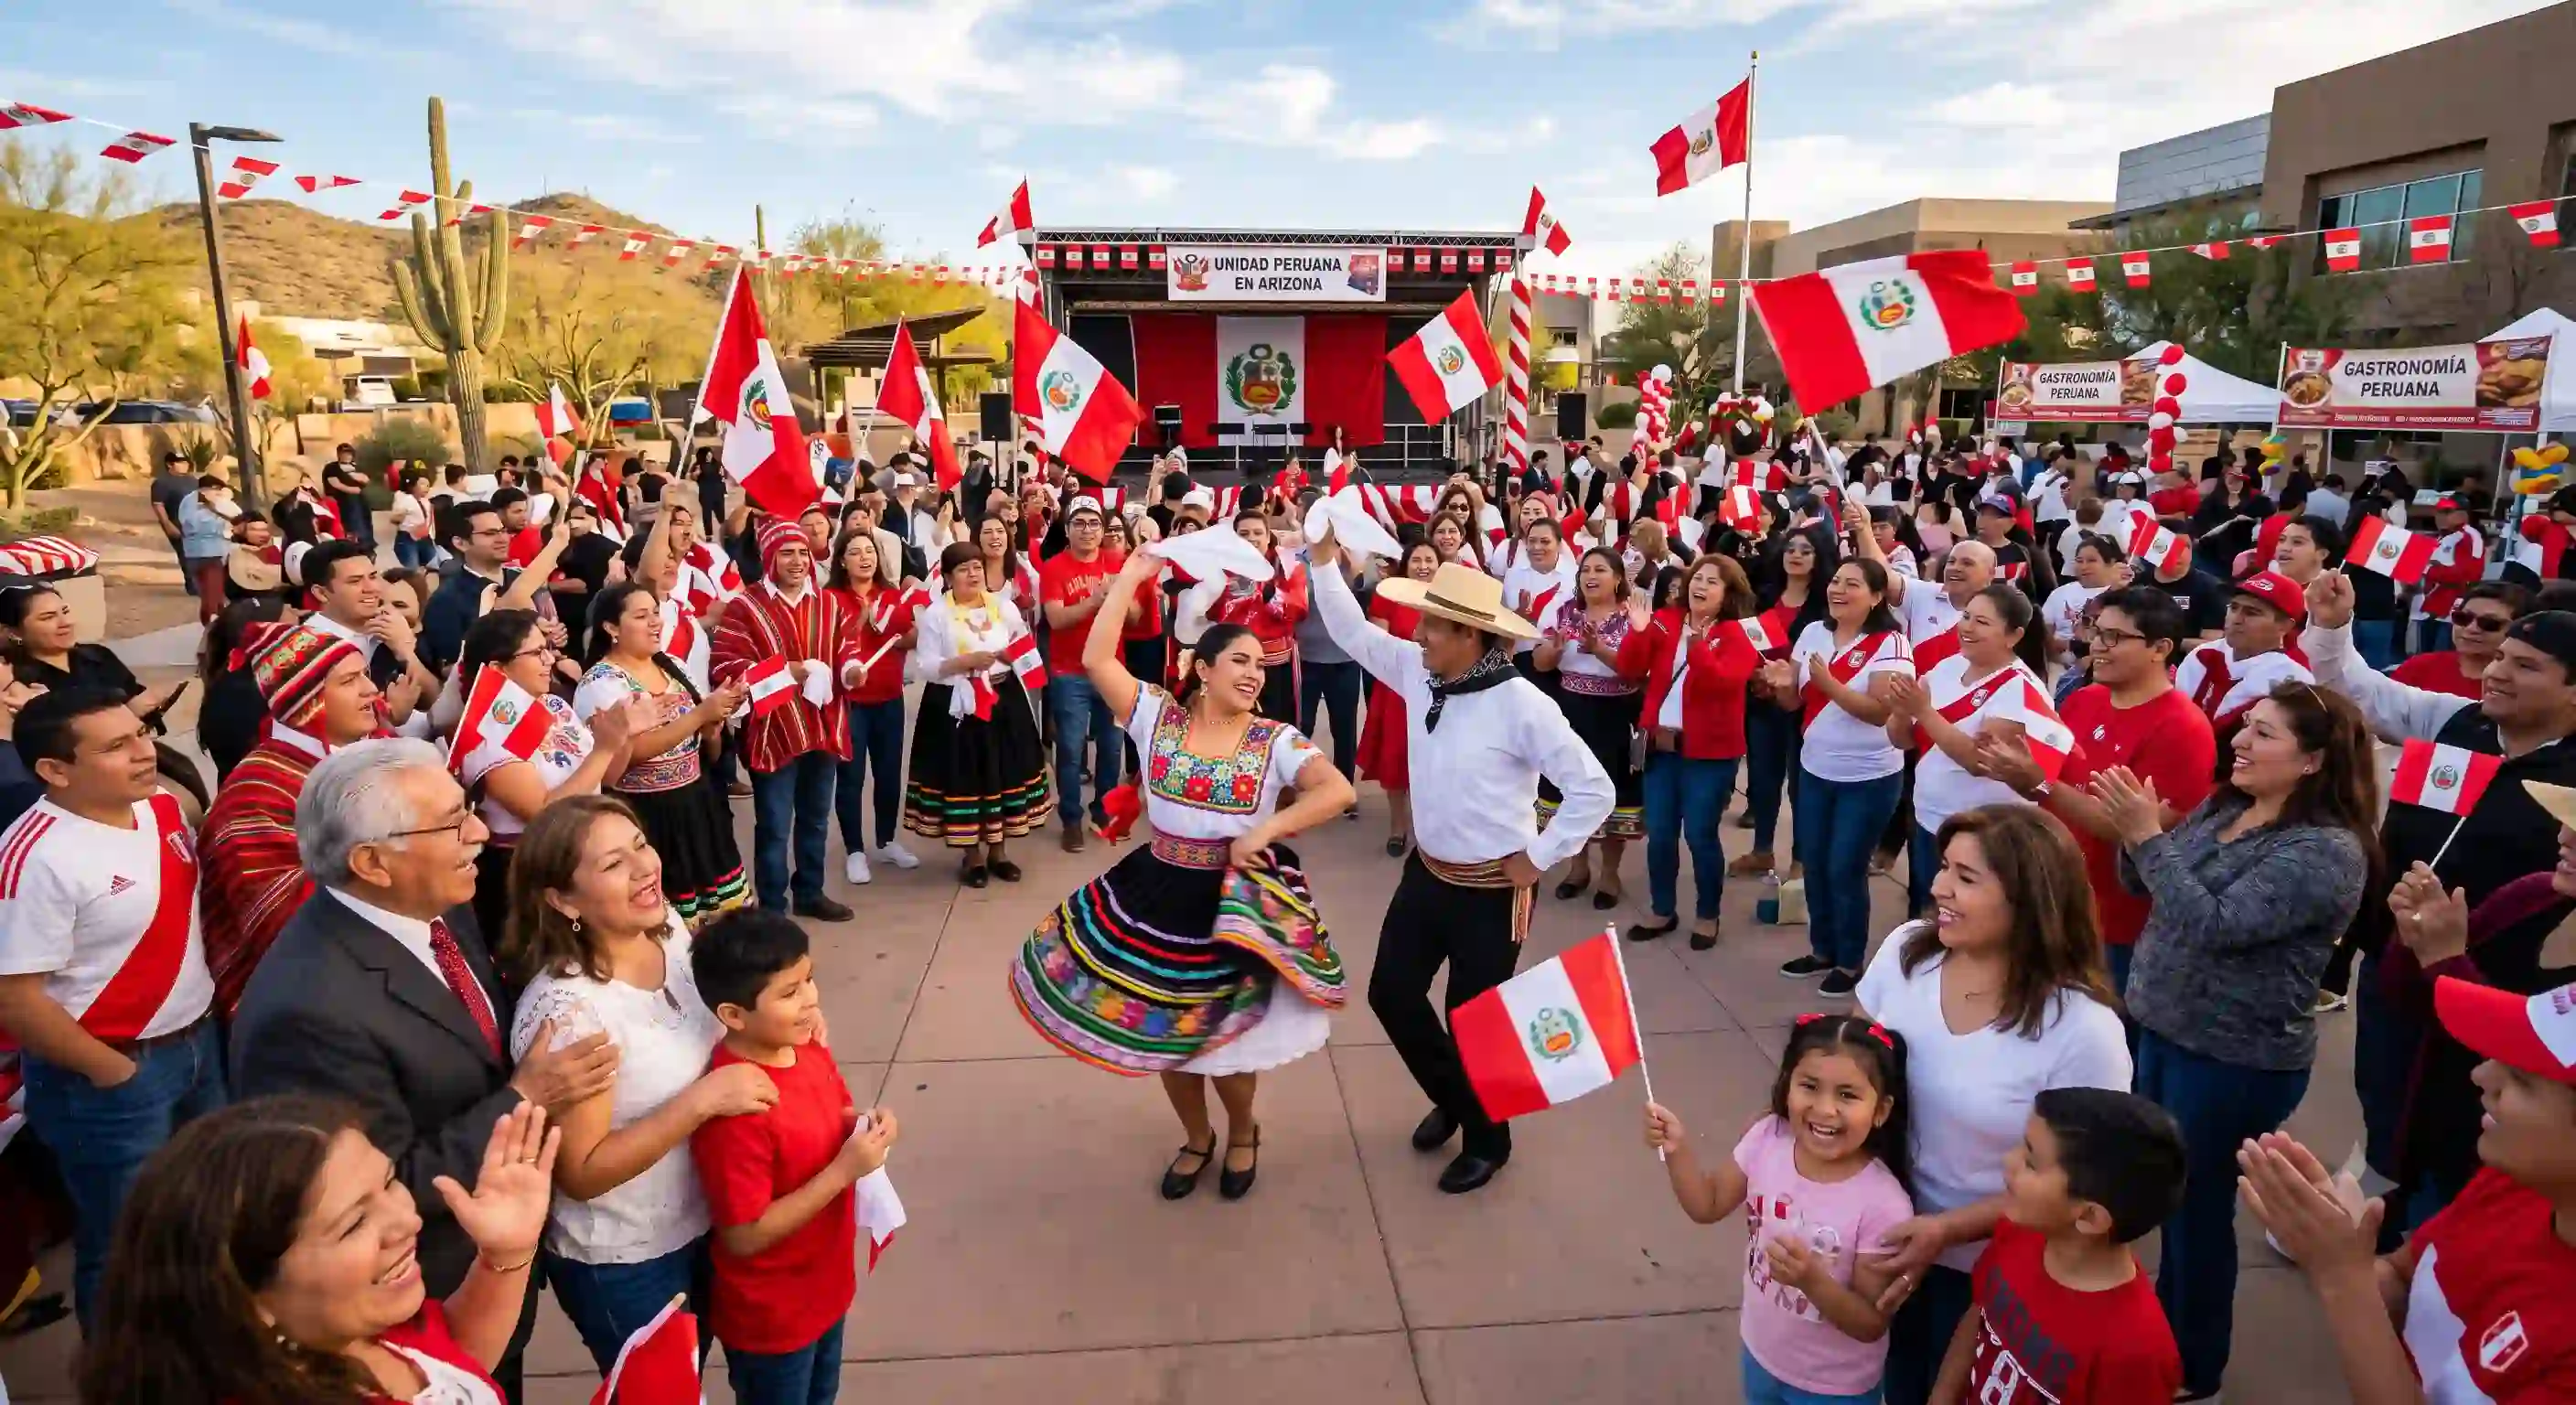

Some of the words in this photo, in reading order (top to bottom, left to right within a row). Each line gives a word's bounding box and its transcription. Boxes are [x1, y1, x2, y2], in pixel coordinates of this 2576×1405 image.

[1214, 258, 1269, 271] UNIDAD
[1274, 258, 1342, 271] PERUANA
[1235, 277, 1253, 290] EN
[1259, 277, 1323, 290] ARIZONA
[2345, 355, 2466, 376] GASTRONOMÍA
[2050, 388, 2099, 400] PERUANA
[2361, 381, 2440, 397] PERUANA
